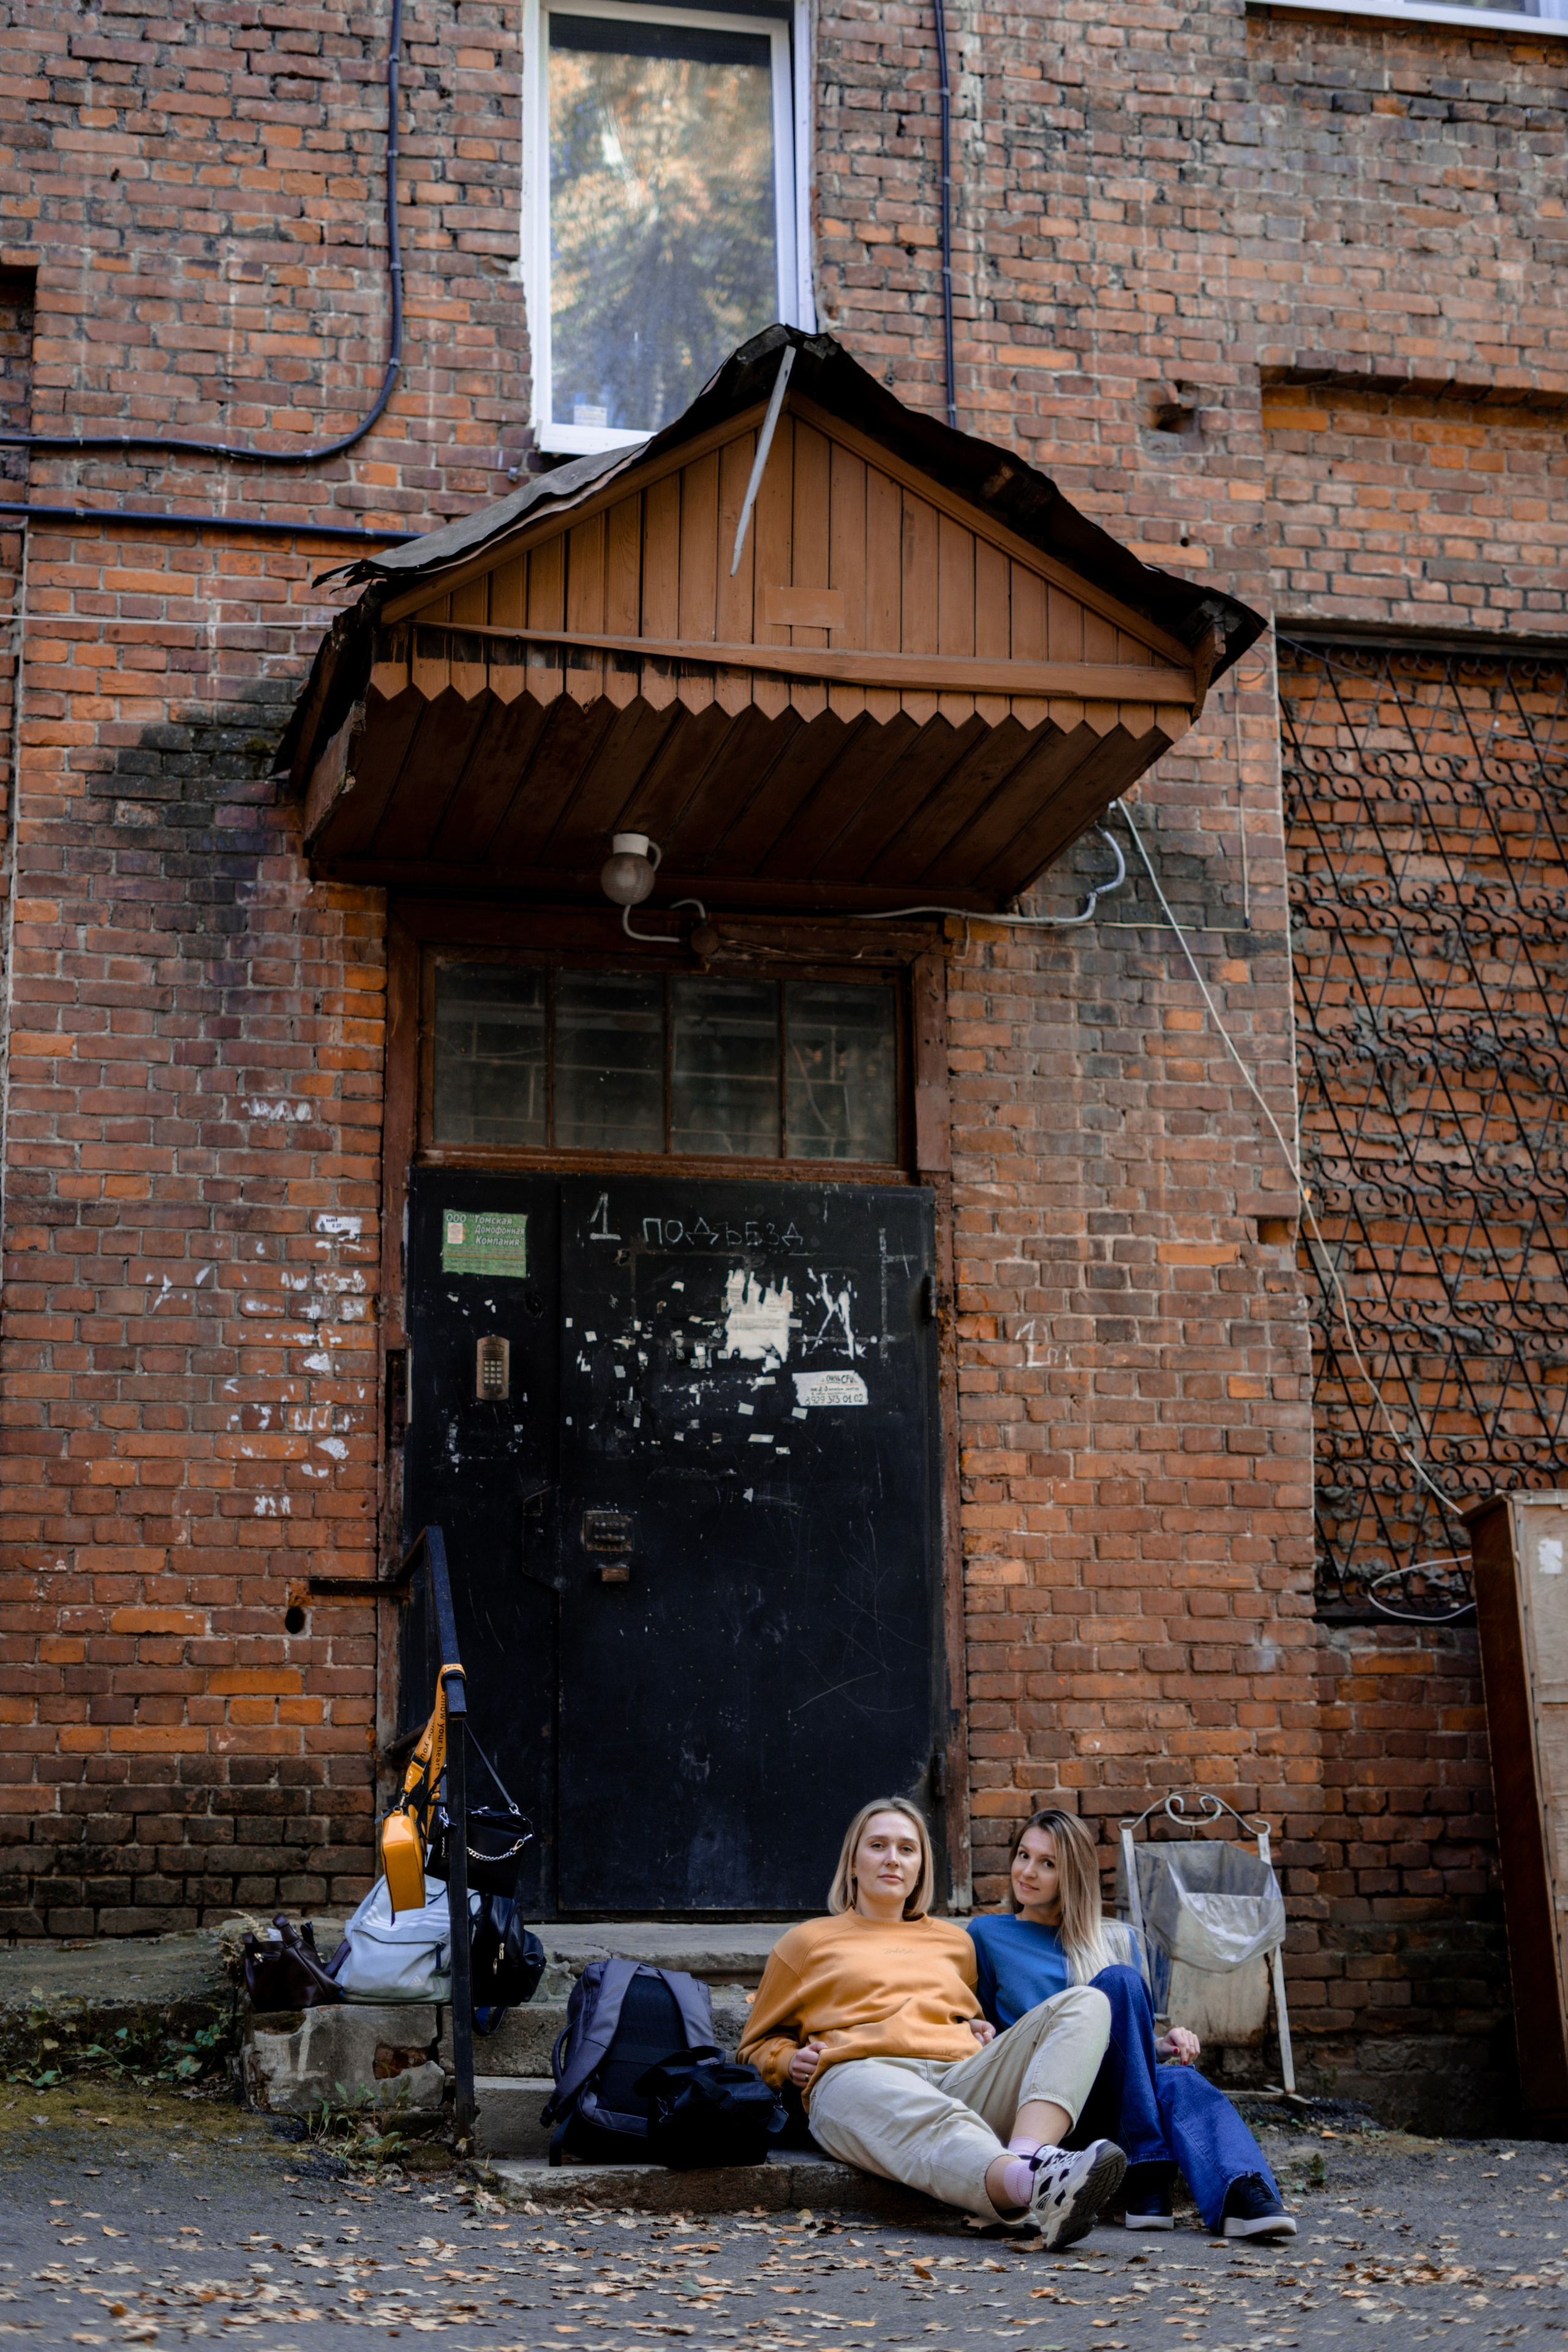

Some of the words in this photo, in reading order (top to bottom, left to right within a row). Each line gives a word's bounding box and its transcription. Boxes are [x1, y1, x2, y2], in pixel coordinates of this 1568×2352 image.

[446, 1213, 467, 1223] ООО
[470, 1215, 512, 1225] "Томская
[589, 1193, 621, 1240] 1
[475, 1224, 525, 1235] Домофонная
[476, 1236, 525, 1246] Компания"
[827, 1395, 840, 1404] 373
[842, 1395, 852, 1403] 01
[854, 1393, 864, 1402] 02
[435, 1746, 443, 1770] heart
